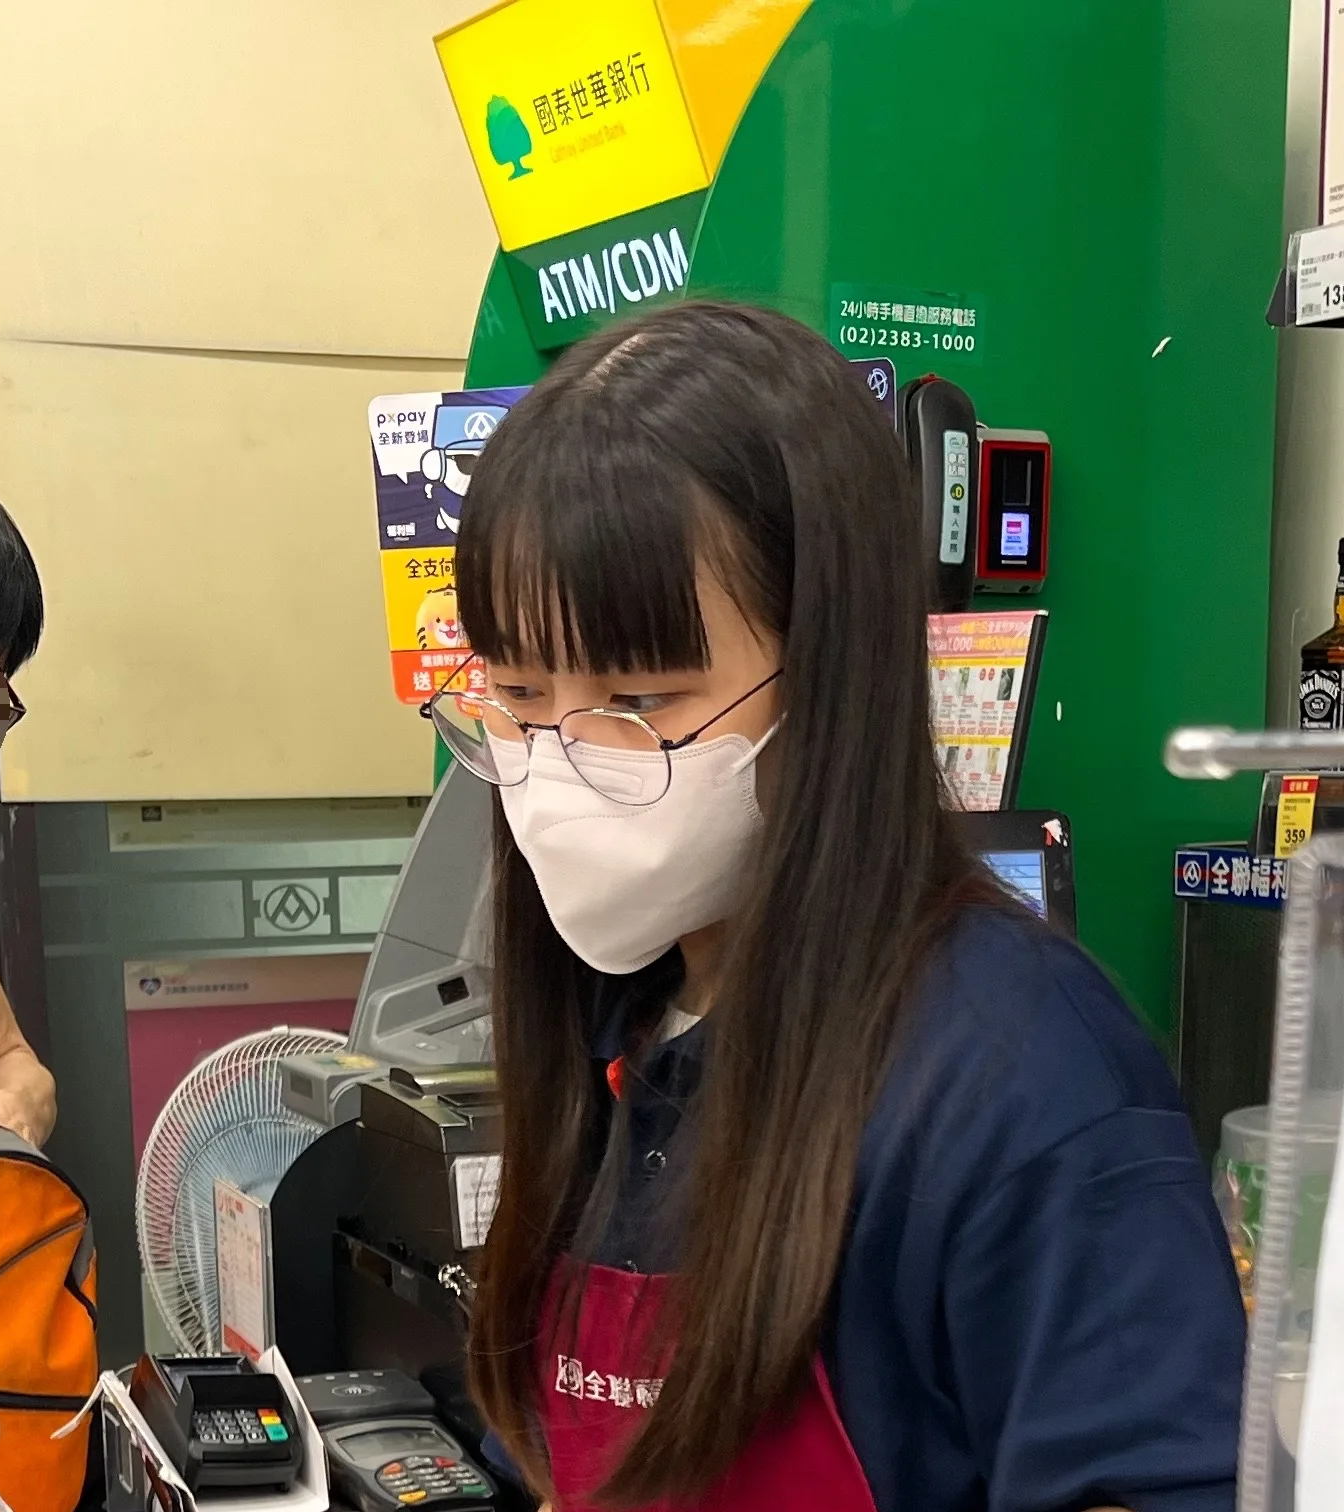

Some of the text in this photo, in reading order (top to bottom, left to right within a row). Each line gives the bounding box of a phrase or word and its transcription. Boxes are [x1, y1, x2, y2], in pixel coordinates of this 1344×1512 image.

[532, 52, 650, 135] 國泰世華銀行
[603, 120, 628, 144] Bank
[538, 227, 688, 323] ATM/CDM
[840, 326, 975, 351] (02)2383-1000
[379, 430, 429, 445] 全新登場
[1299, 674, 1316, 700] JACK
[1284, 829, 1305, 844] 359
[1211, 856, 1289, 900] 全聯福利
